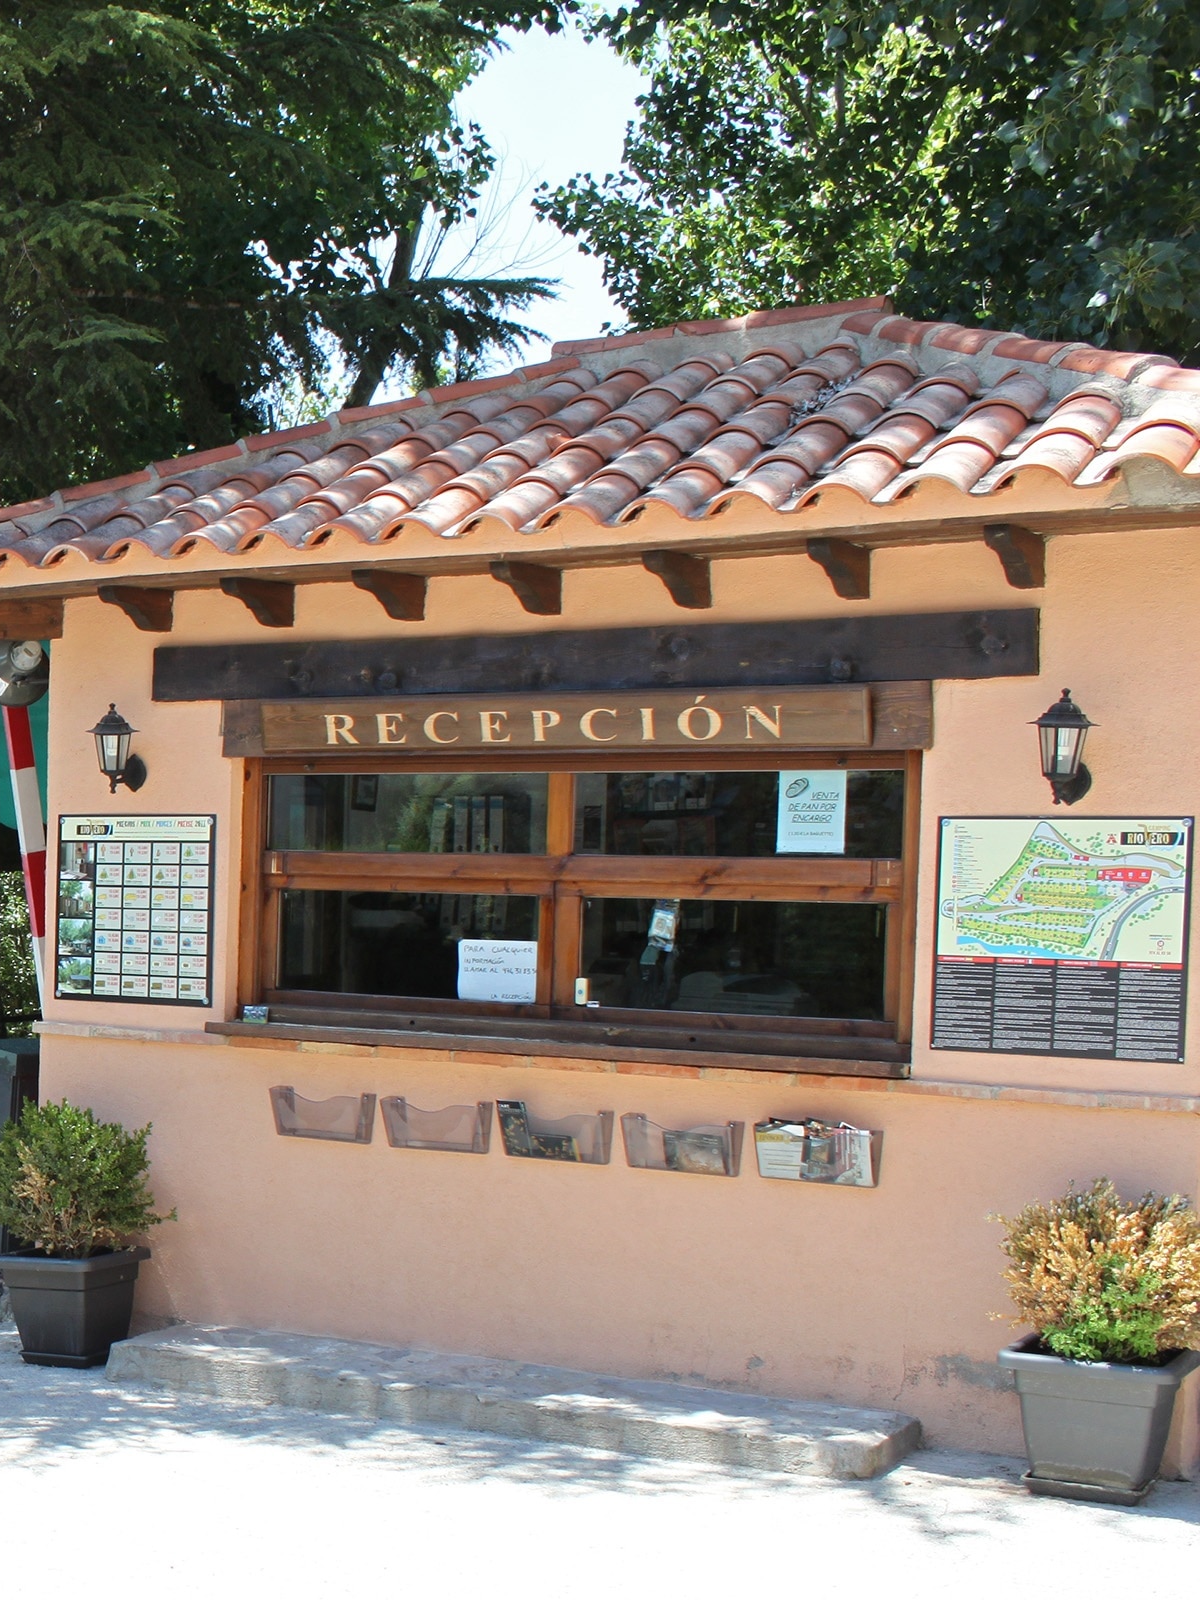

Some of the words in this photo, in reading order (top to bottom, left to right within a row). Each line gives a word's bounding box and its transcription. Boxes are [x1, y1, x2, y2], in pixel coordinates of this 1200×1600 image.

[324, 696, 782, 745] RECEPCIÓN
[792, 814, 832, 822] ENCARGO
[1127, 833, 1144, 845] RIO
[464, 945, 485, 953] PARA
[492, 946, 533, 955] CUALQUIER
